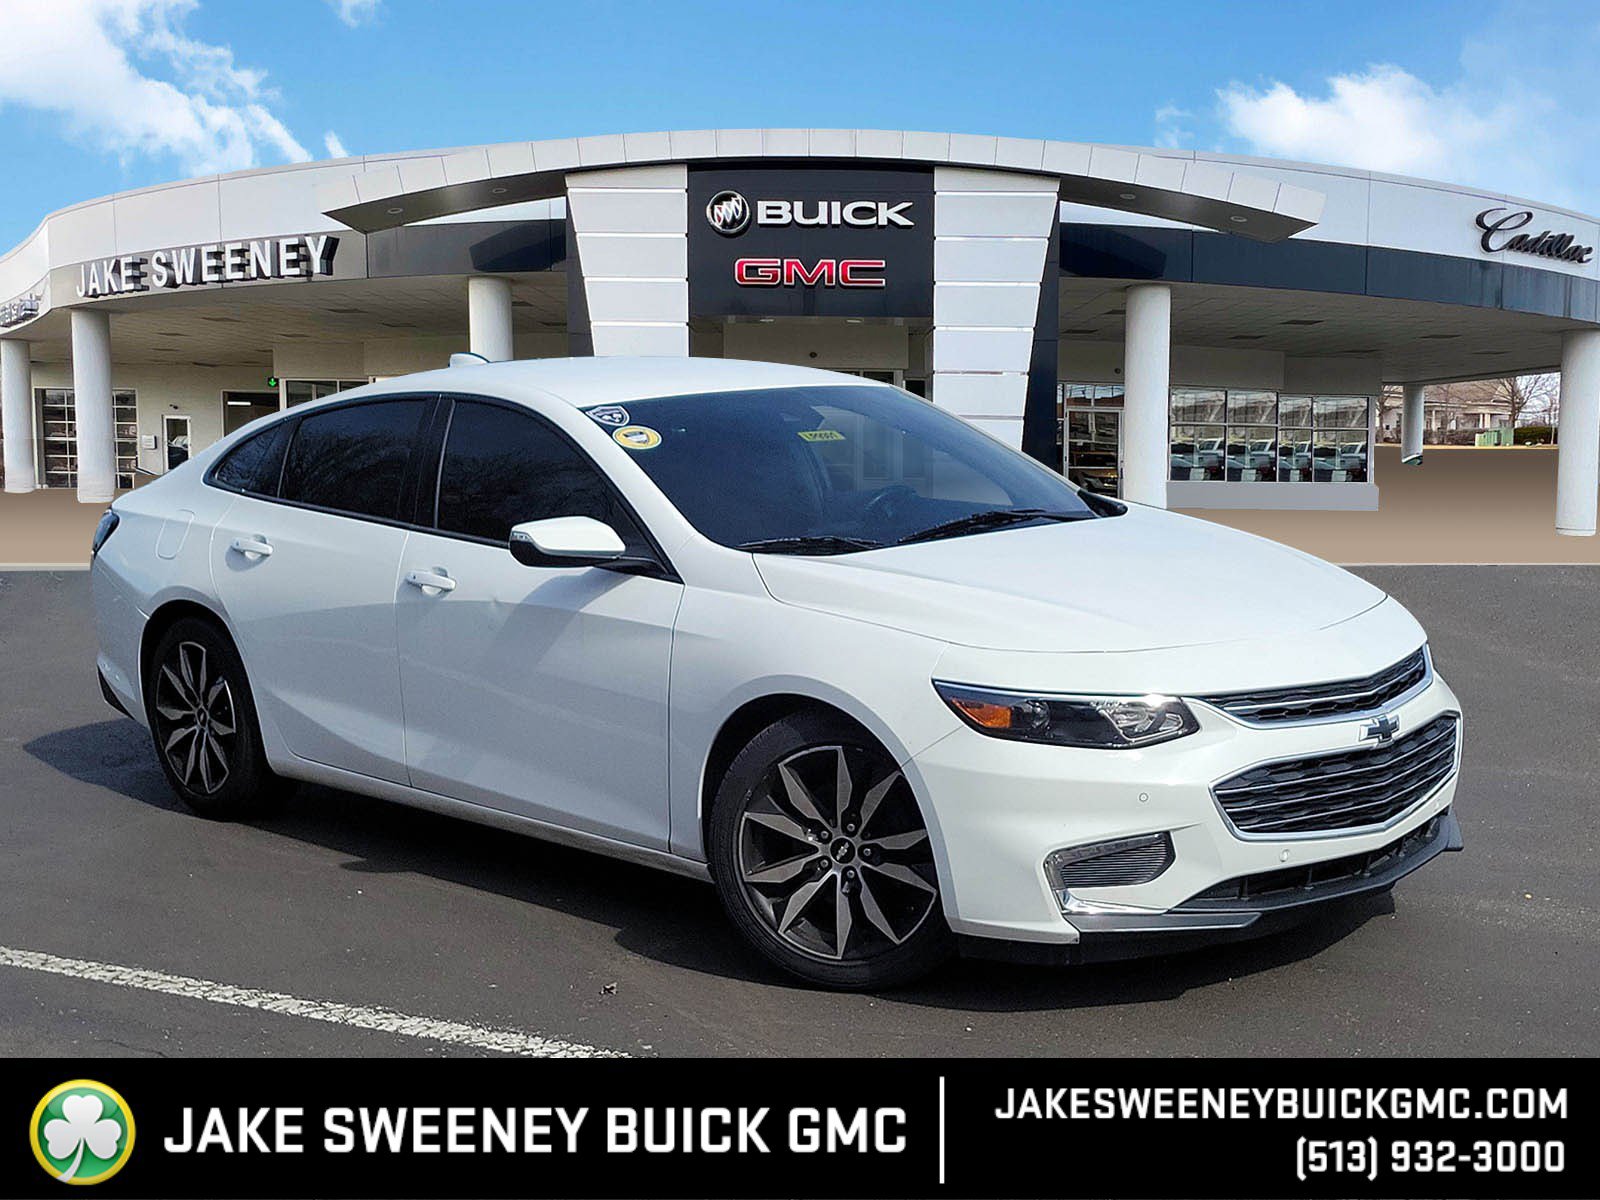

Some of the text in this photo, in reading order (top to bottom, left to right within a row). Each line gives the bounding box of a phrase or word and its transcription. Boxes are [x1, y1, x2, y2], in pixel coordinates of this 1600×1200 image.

[757, 200, 915, 226] BUICK
[1475, 207, 1594, 264] Cadillac
[76, 234, 333, 299] JAKE SWEENEY
[734, 258, 887, 287] GMC
